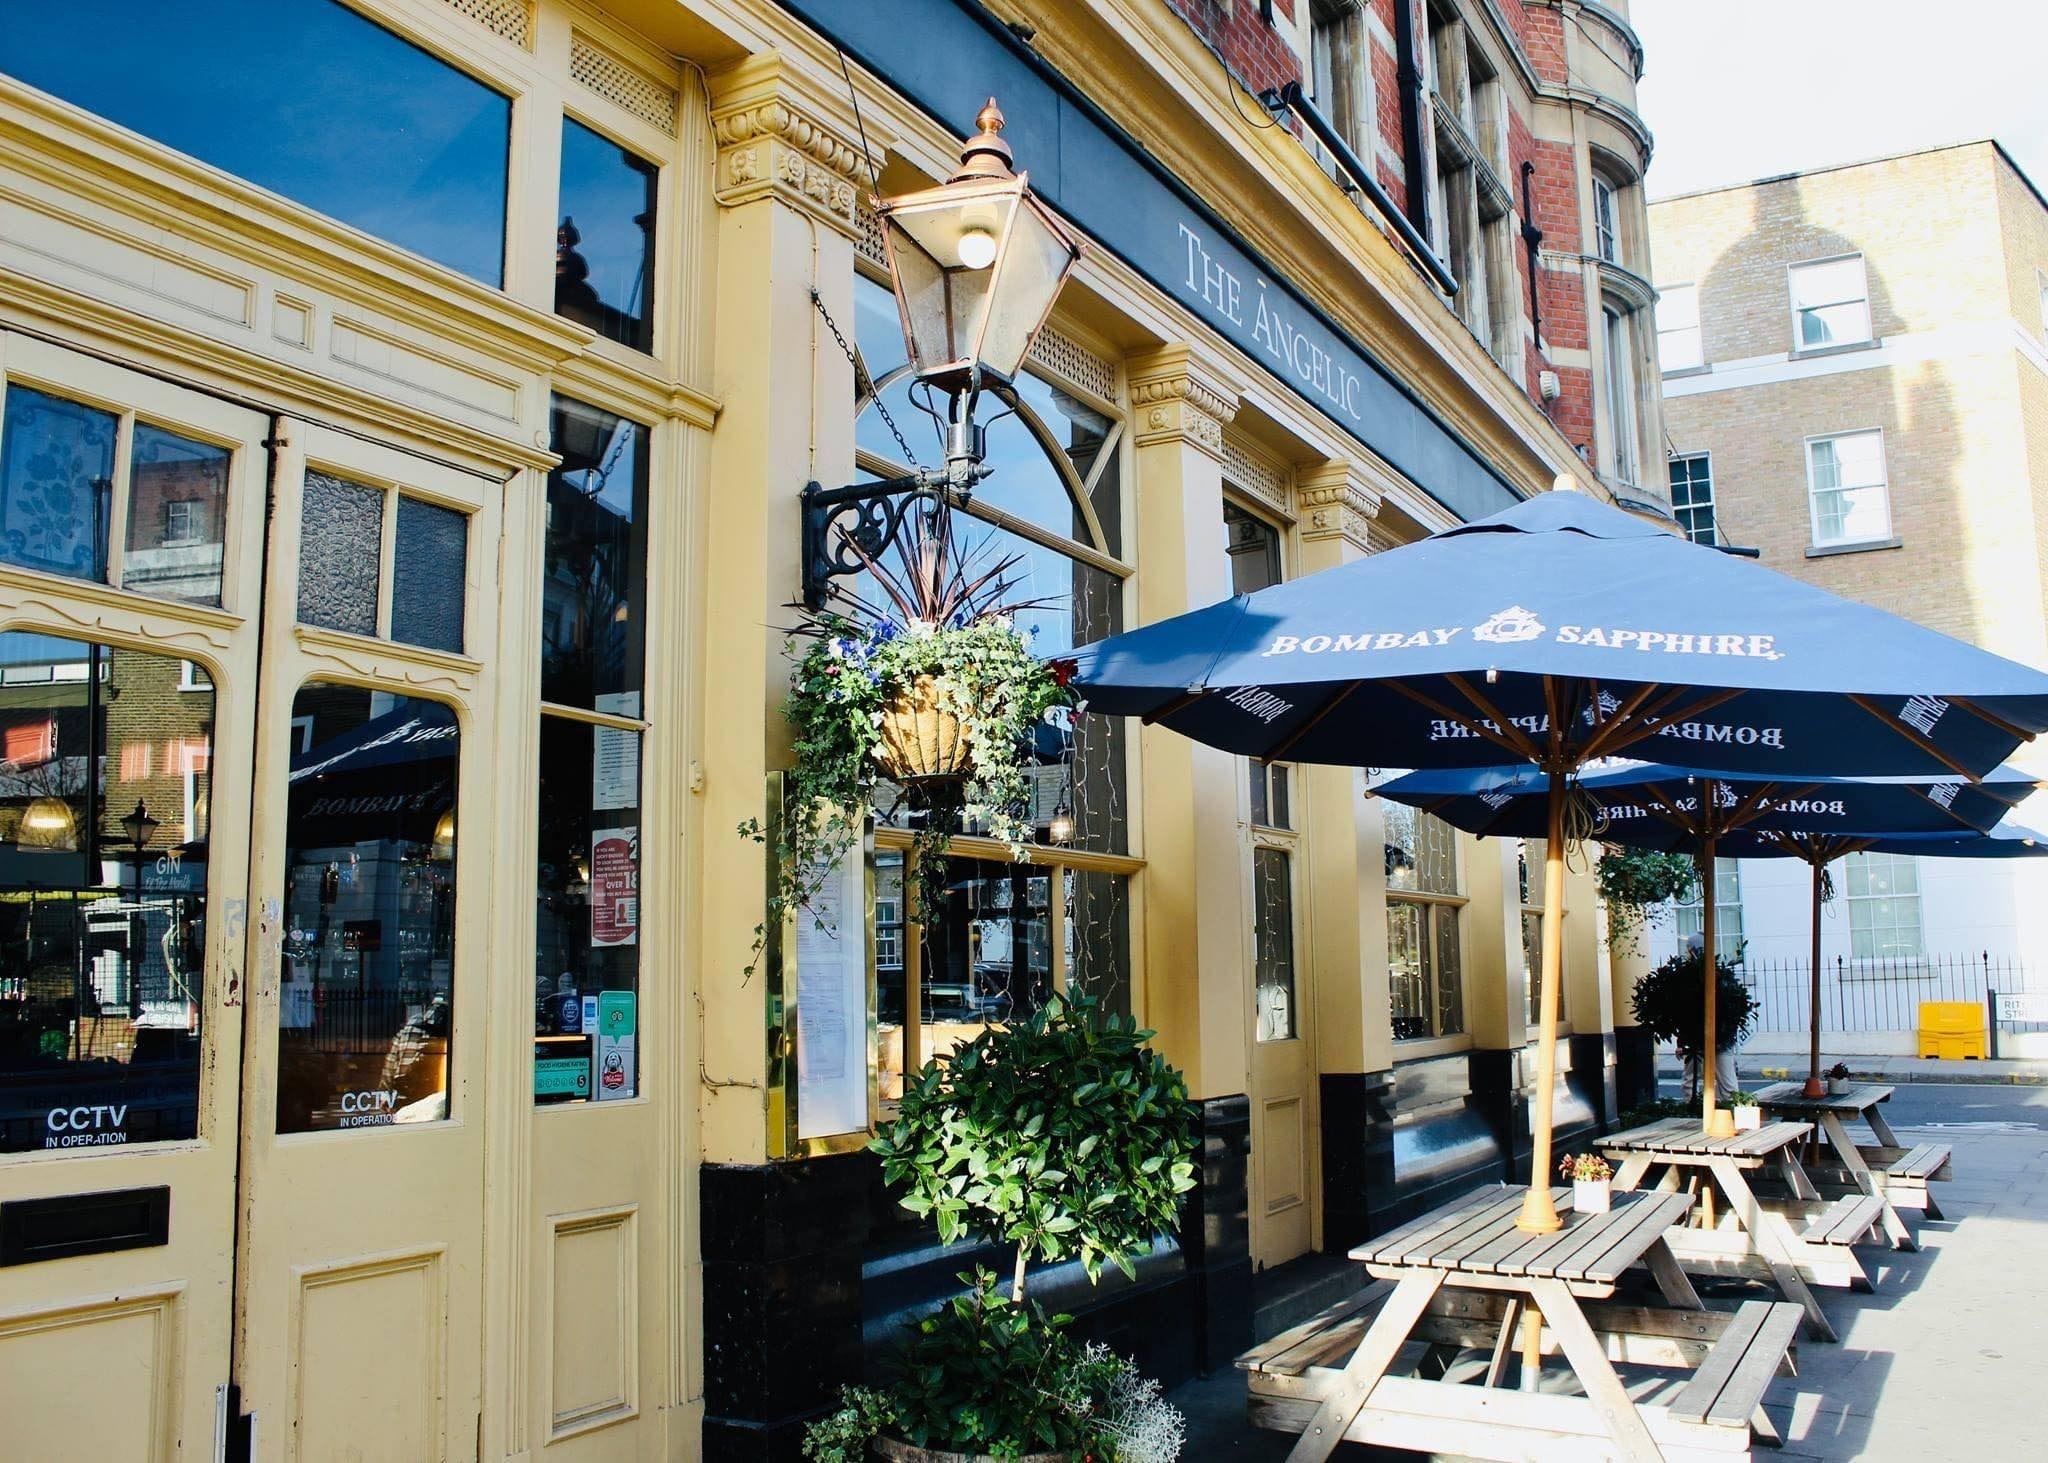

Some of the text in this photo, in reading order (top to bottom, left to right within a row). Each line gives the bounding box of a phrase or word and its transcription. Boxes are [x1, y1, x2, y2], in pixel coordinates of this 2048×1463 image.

[1178, 223, 1243, 327] THE
[1262, 625, 1785, 660] BOMBAY SAPPHIRE
[156, 856, 180, 875] GIN
[606, 881, 623, 889] OVER
[341, 1090, 398, 1112] CCTV
[47, 1105, 127, 1131] CCTV
[340, 1114, 396, 1127] IN OPERATIO
[46, 1132, 126, 1148] IN OPERATION
